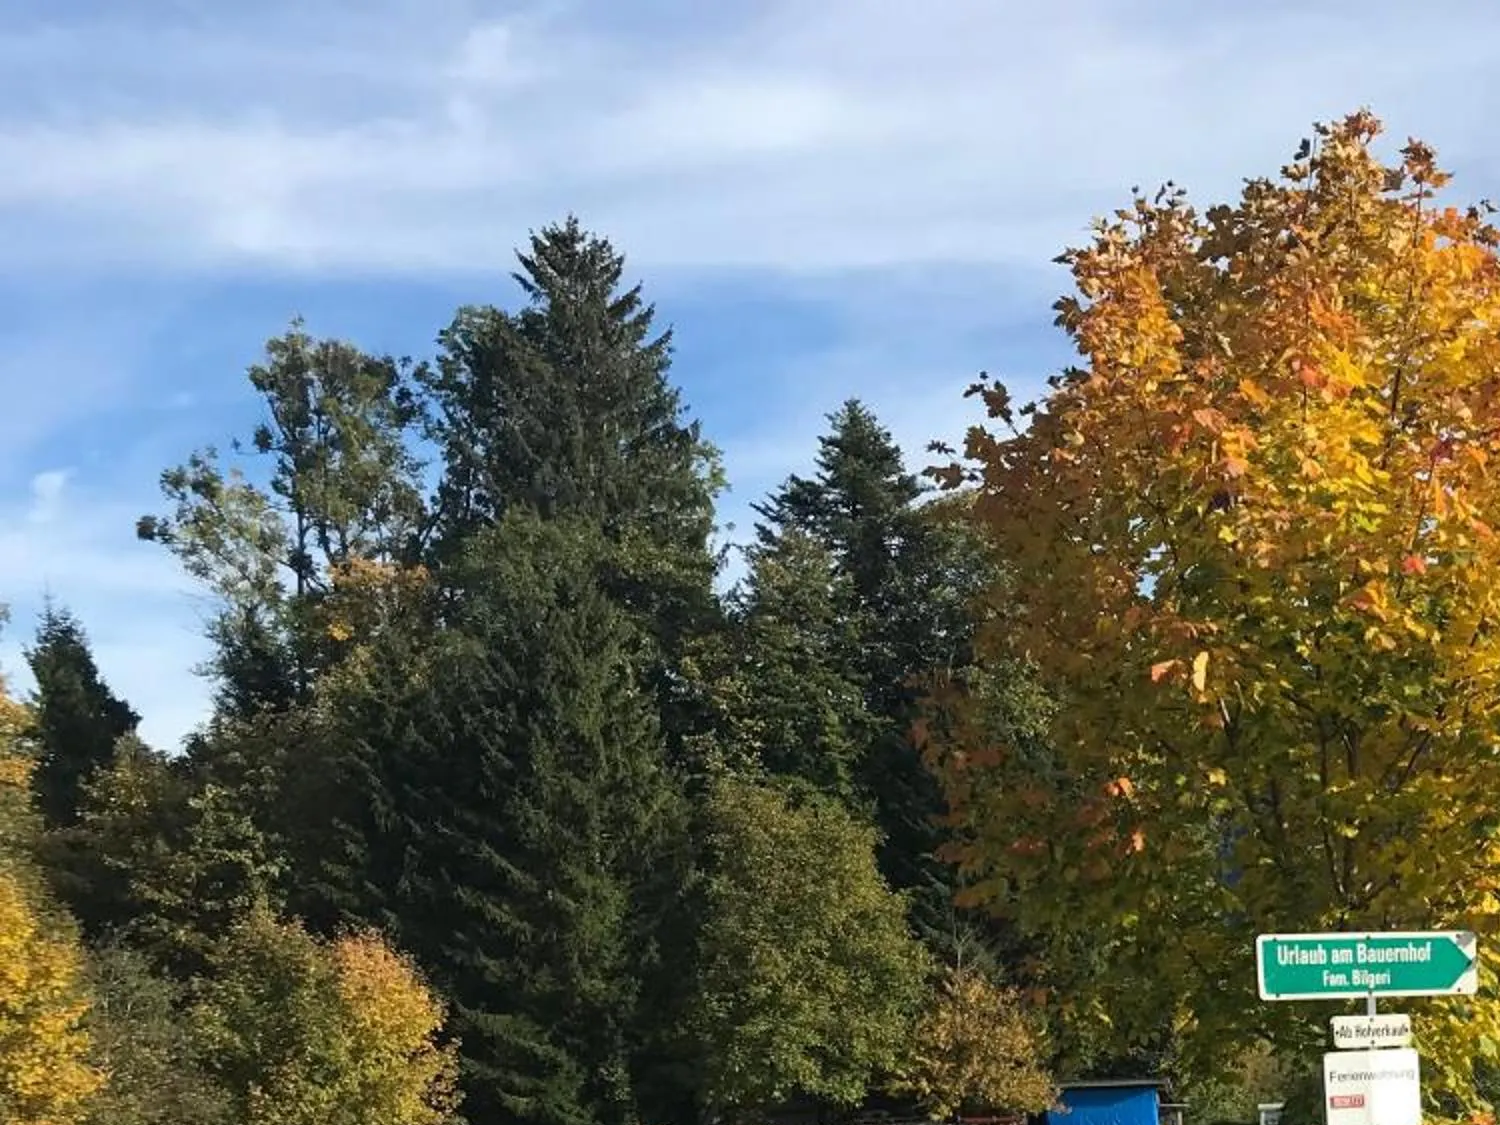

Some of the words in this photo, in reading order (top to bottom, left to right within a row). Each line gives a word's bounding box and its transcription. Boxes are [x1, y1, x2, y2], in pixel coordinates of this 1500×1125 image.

[1277, 943, 1327, 965] Urlaub
[1331, 950, 1353, 964] am
[1356, 942, 1432, 963] Bauernhof
[1322, 971, 1349, 987] Fam.
[1352, 969, 1391, 988] Bilgeri
